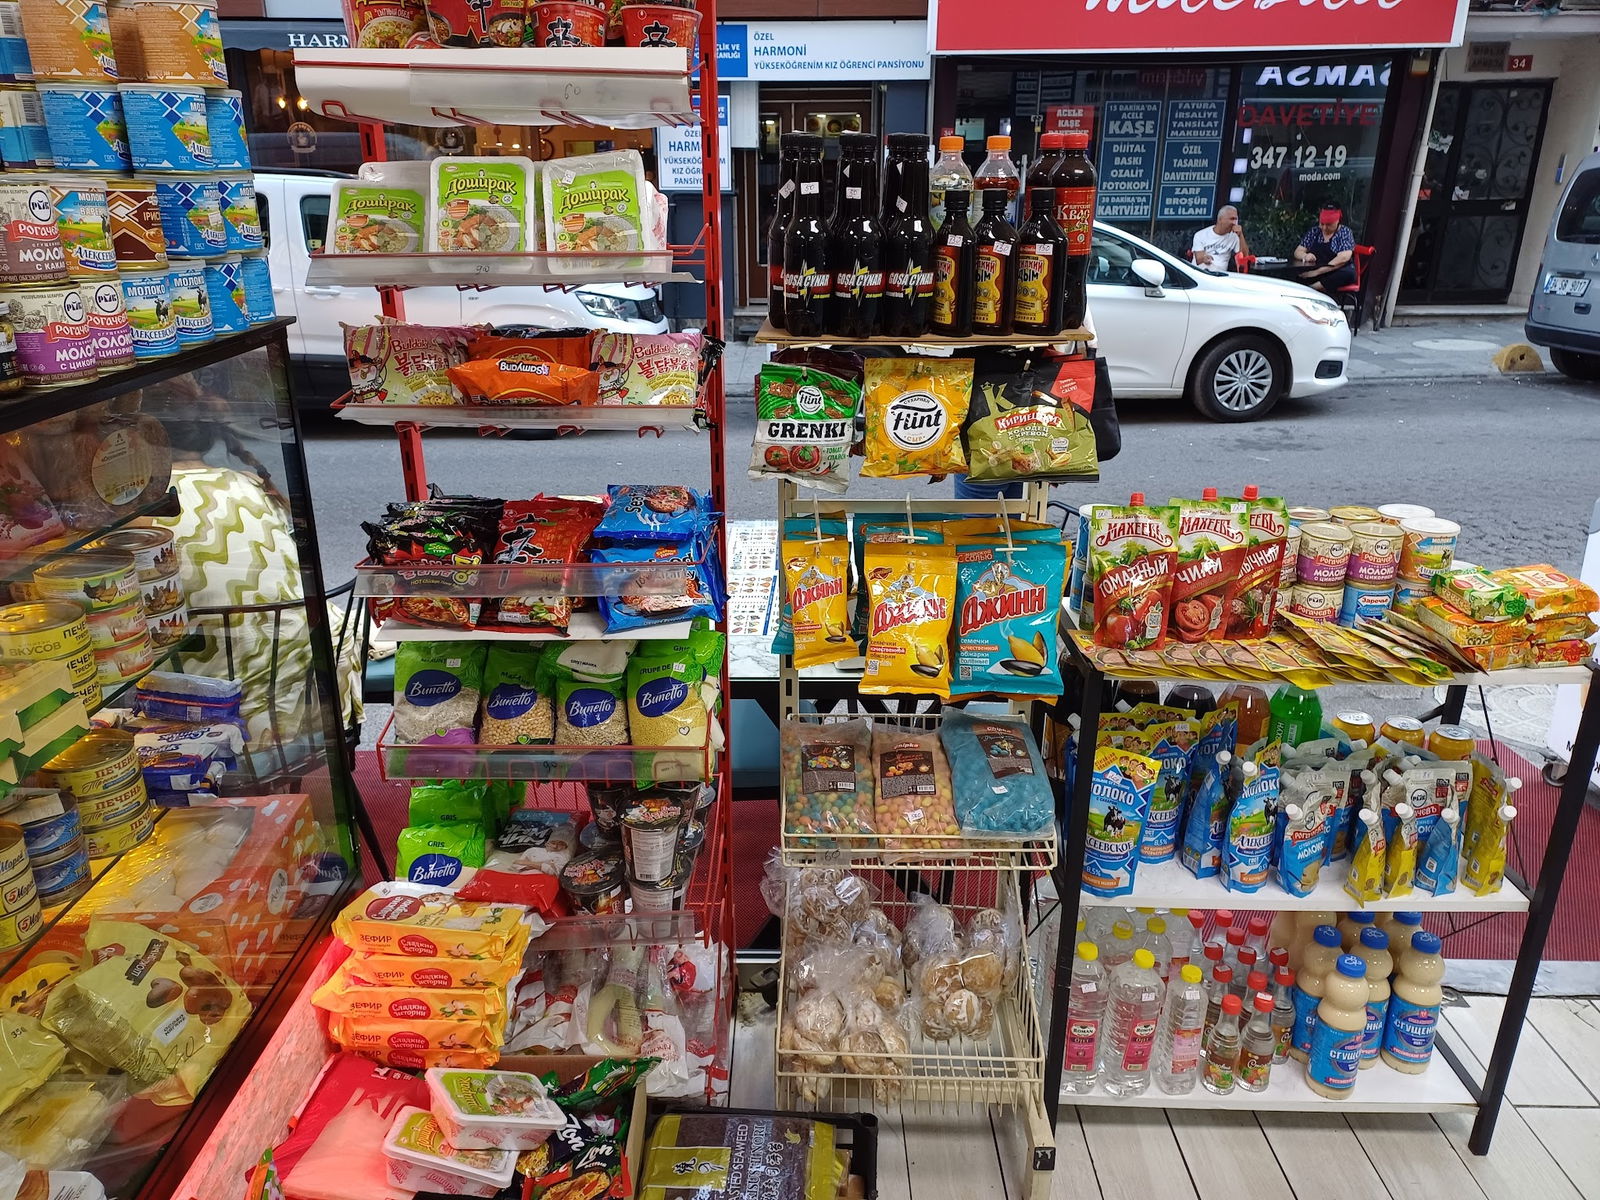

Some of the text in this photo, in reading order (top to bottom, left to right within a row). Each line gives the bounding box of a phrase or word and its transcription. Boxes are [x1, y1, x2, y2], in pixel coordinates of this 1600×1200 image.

[753, 31, 775, 41] ÖZEL
[753, 44, 807, 56] HARMONİ
[753, 58, 924, 70] YÜKSEKÖĞRENİM KIZ ÖĞRENCİ PANSİYONU
[1512, 58, 1526, 69] 34
[1056, 108, 1084, 117] ACELE
[1174, 110, 1218, 118] İRSALİYE
[1237, 98, 1377, 127] DAVETİYE
[1057, 119, 1080, 129] KAŞE
[1108, 120, 1155, 139] KAŞE
[1112, 141, 1146, 153] DİJİTAL
[1182, 144, 1202, 154] ÖZEL
[1114, 156, 1142, 165] BASKI
[1251, 145, 1347, 169] 347 12 19
[1173, 159, 1208, 168] TASARIM
[672, 167, 684, 175] KIZ
[1110, 166, 1144, 178] OZALİT
[1164, 170, 1215, 181] DAVETİYELER
[1299, 171, 1341, 182] moda.com
[446, 177, 517, 197] Доширак
[1102, 179, 1149, 190] FOTOKOPİ
[1174, 187, 1201, 195] ZARF
[344, 198, 416, 213] Доширак
[559, 188, 630, 212] Доширак
[1165, 195, 1208, 207] BROŞÜR
[1056, 204, 1090, 220] Квас
[1097, 203, 1150, 216] KARTVİZİT
[1177, 205, 1207, 215] İLANI
[127, 285, 166, 297] МОЛОКО
[768, 421, 847, 439] GRENKI
[1313, 567, 1347, 578] МОЛОКО
[1358, 565, 1395, 575] МОЛОКО
[1099, 555, 1169, 598] ТОМАТНЫЙ
[960, 587, 1046, 636] ДЖИНН
[63, 621, 87, 639] ПЕЧЕ
[9, 641, 62, 657] ВКУСОВ
[408, 679, 457, 698] Bunetto
[488, 690, 534, 709] Bunetto
[640, 682, 685, 708] Bunetto
[569, 697, 614, 718] Bunetto
[95, 784, 142, 811] ПЕЧЕНЬ
[360, 933, 393, 943] ЗЕФИР
[401, 938, 434, 950] Сладкие
[413, 971, 449, 980] Сладкие
[392, 1003, 427, 1013] Сладкие
[1393, 1018, 1436, 1036] СГУЩЕН
[390, 1036, 426, 1046] Сладкие
[732, 1124, 749, 1169] SEAWEED
